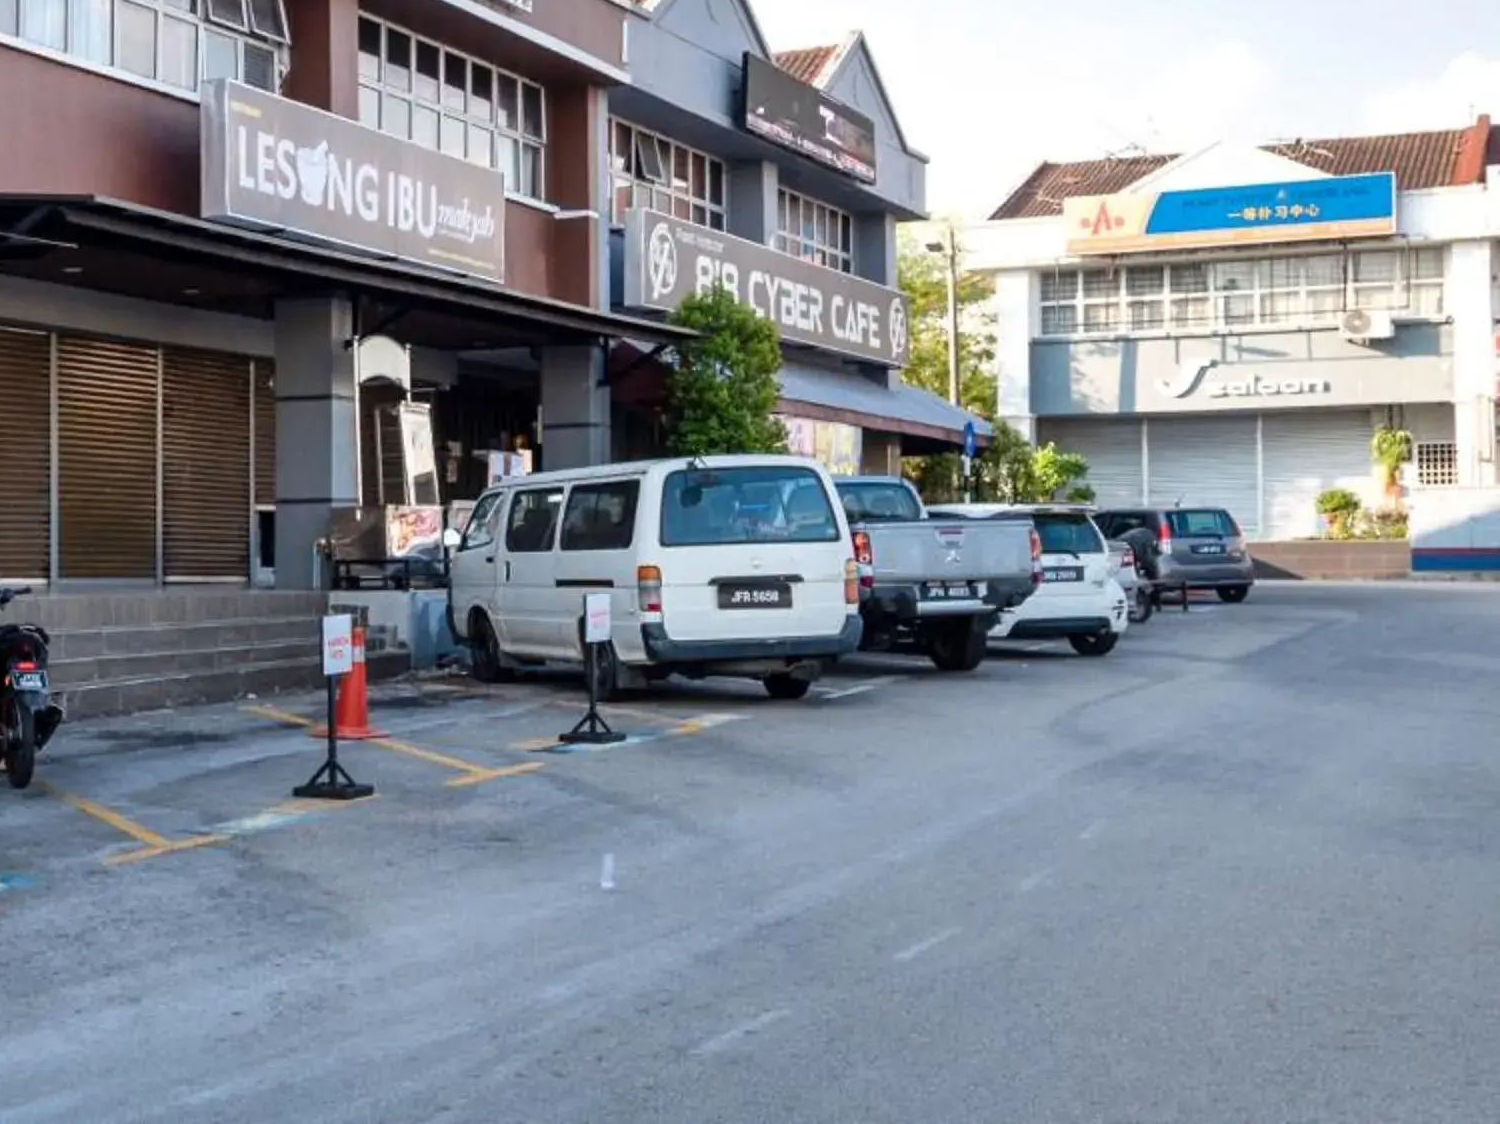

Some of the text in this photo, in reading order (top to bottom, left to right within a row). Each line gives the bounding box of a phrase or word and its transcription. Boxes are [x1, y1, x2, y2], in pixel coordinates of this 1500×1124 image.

[386, 171, 438, 239] IBU
[748, 270, 825, 336] CYBER
[831, 293, 882, 350] CAFE
